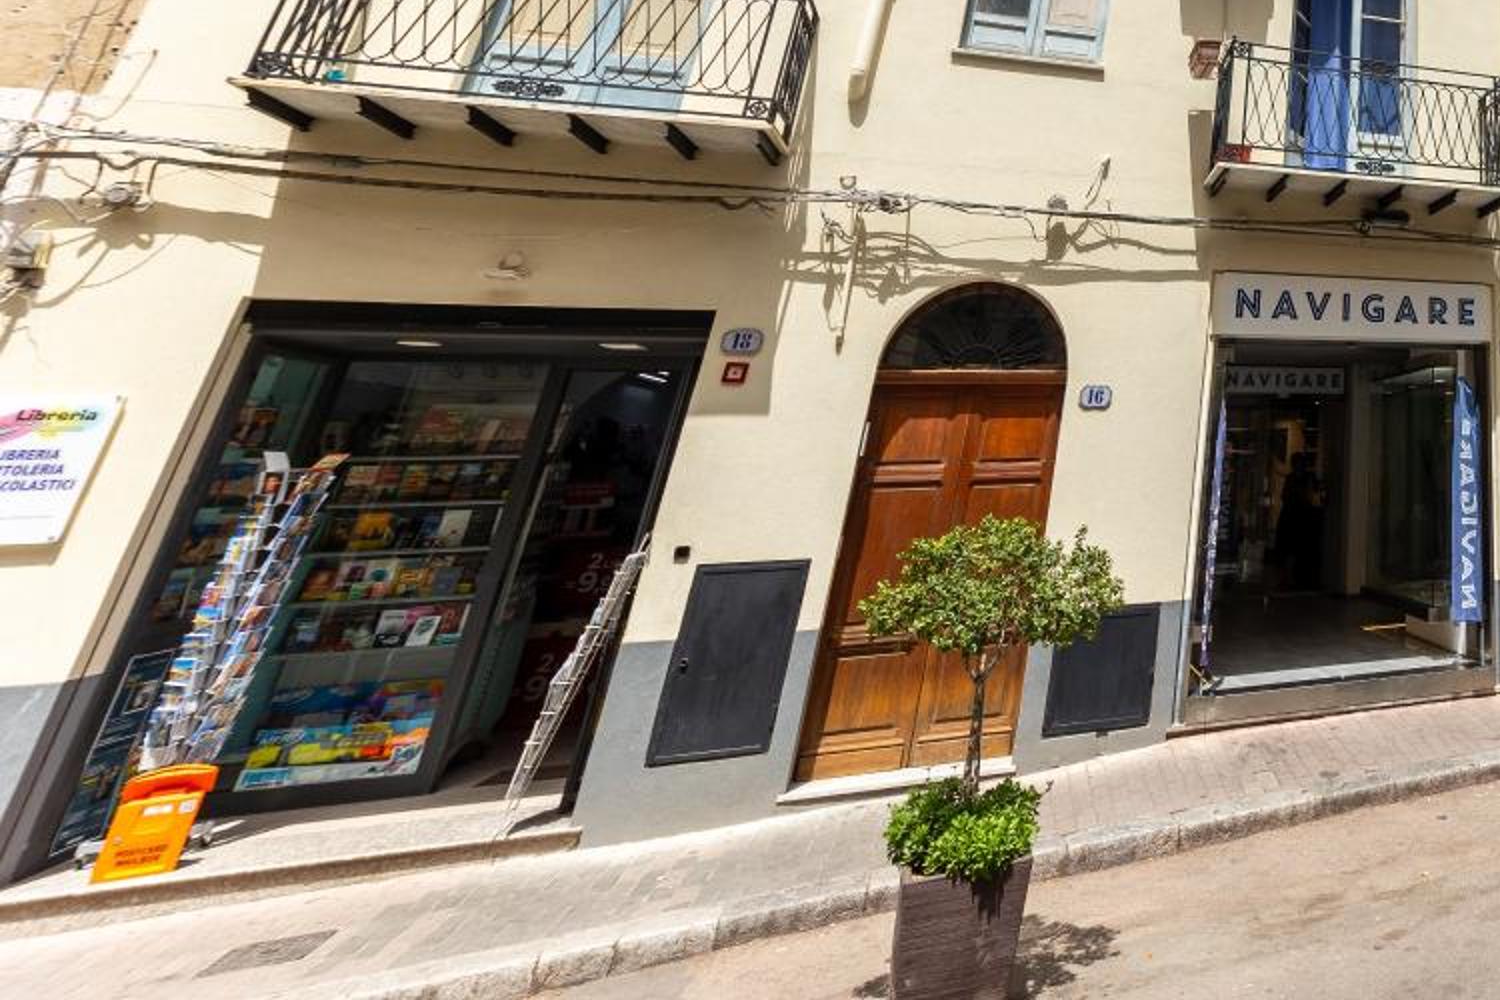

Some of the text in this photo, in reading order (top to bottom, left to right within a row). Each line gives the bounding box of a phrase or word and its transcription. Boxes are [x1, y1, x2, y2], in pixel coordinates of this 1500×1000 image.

[1235, 287, 1475, 326] NAVIGARE
[732, 332, 753, 349] 18
[1225, 373, 1342, 388] NAVIGARE
[1087, 388, 1105, 405] 16
[16, 409, 98, 422] Libreria
